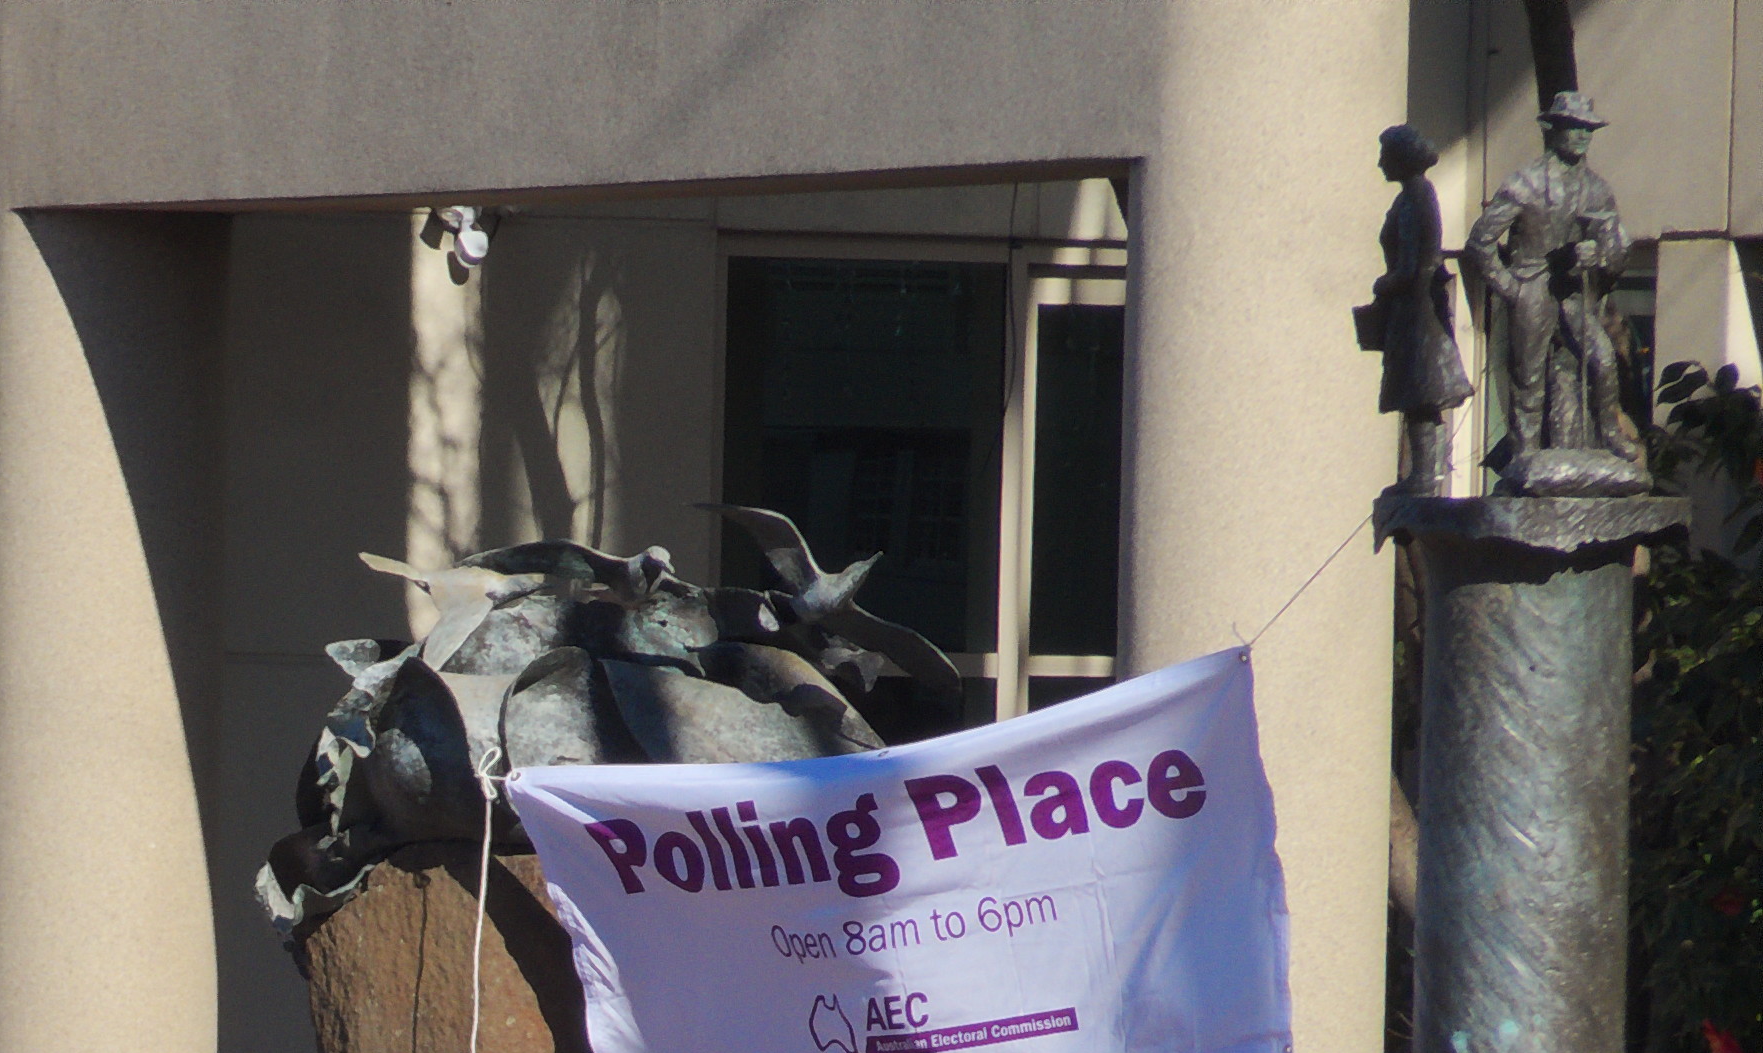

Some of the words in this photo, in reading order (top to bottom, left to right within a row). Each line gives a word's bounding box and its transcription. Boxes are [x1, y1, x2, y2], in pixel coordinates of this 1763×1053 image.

[587, 791, 901, 899] Polling
[904, 748, 1206, 861] Place
[771, 924, 837, 964] Open
[842, 920, 921, 956] 8am
[930, 908, 966, 941] to
[977, 894, 1058, 937] 6pm
[866, 992, 929, 1031] AEC
[930, 1027, 988, 1048] Electoral
[991, 1014, 1072, 1038] Commission
